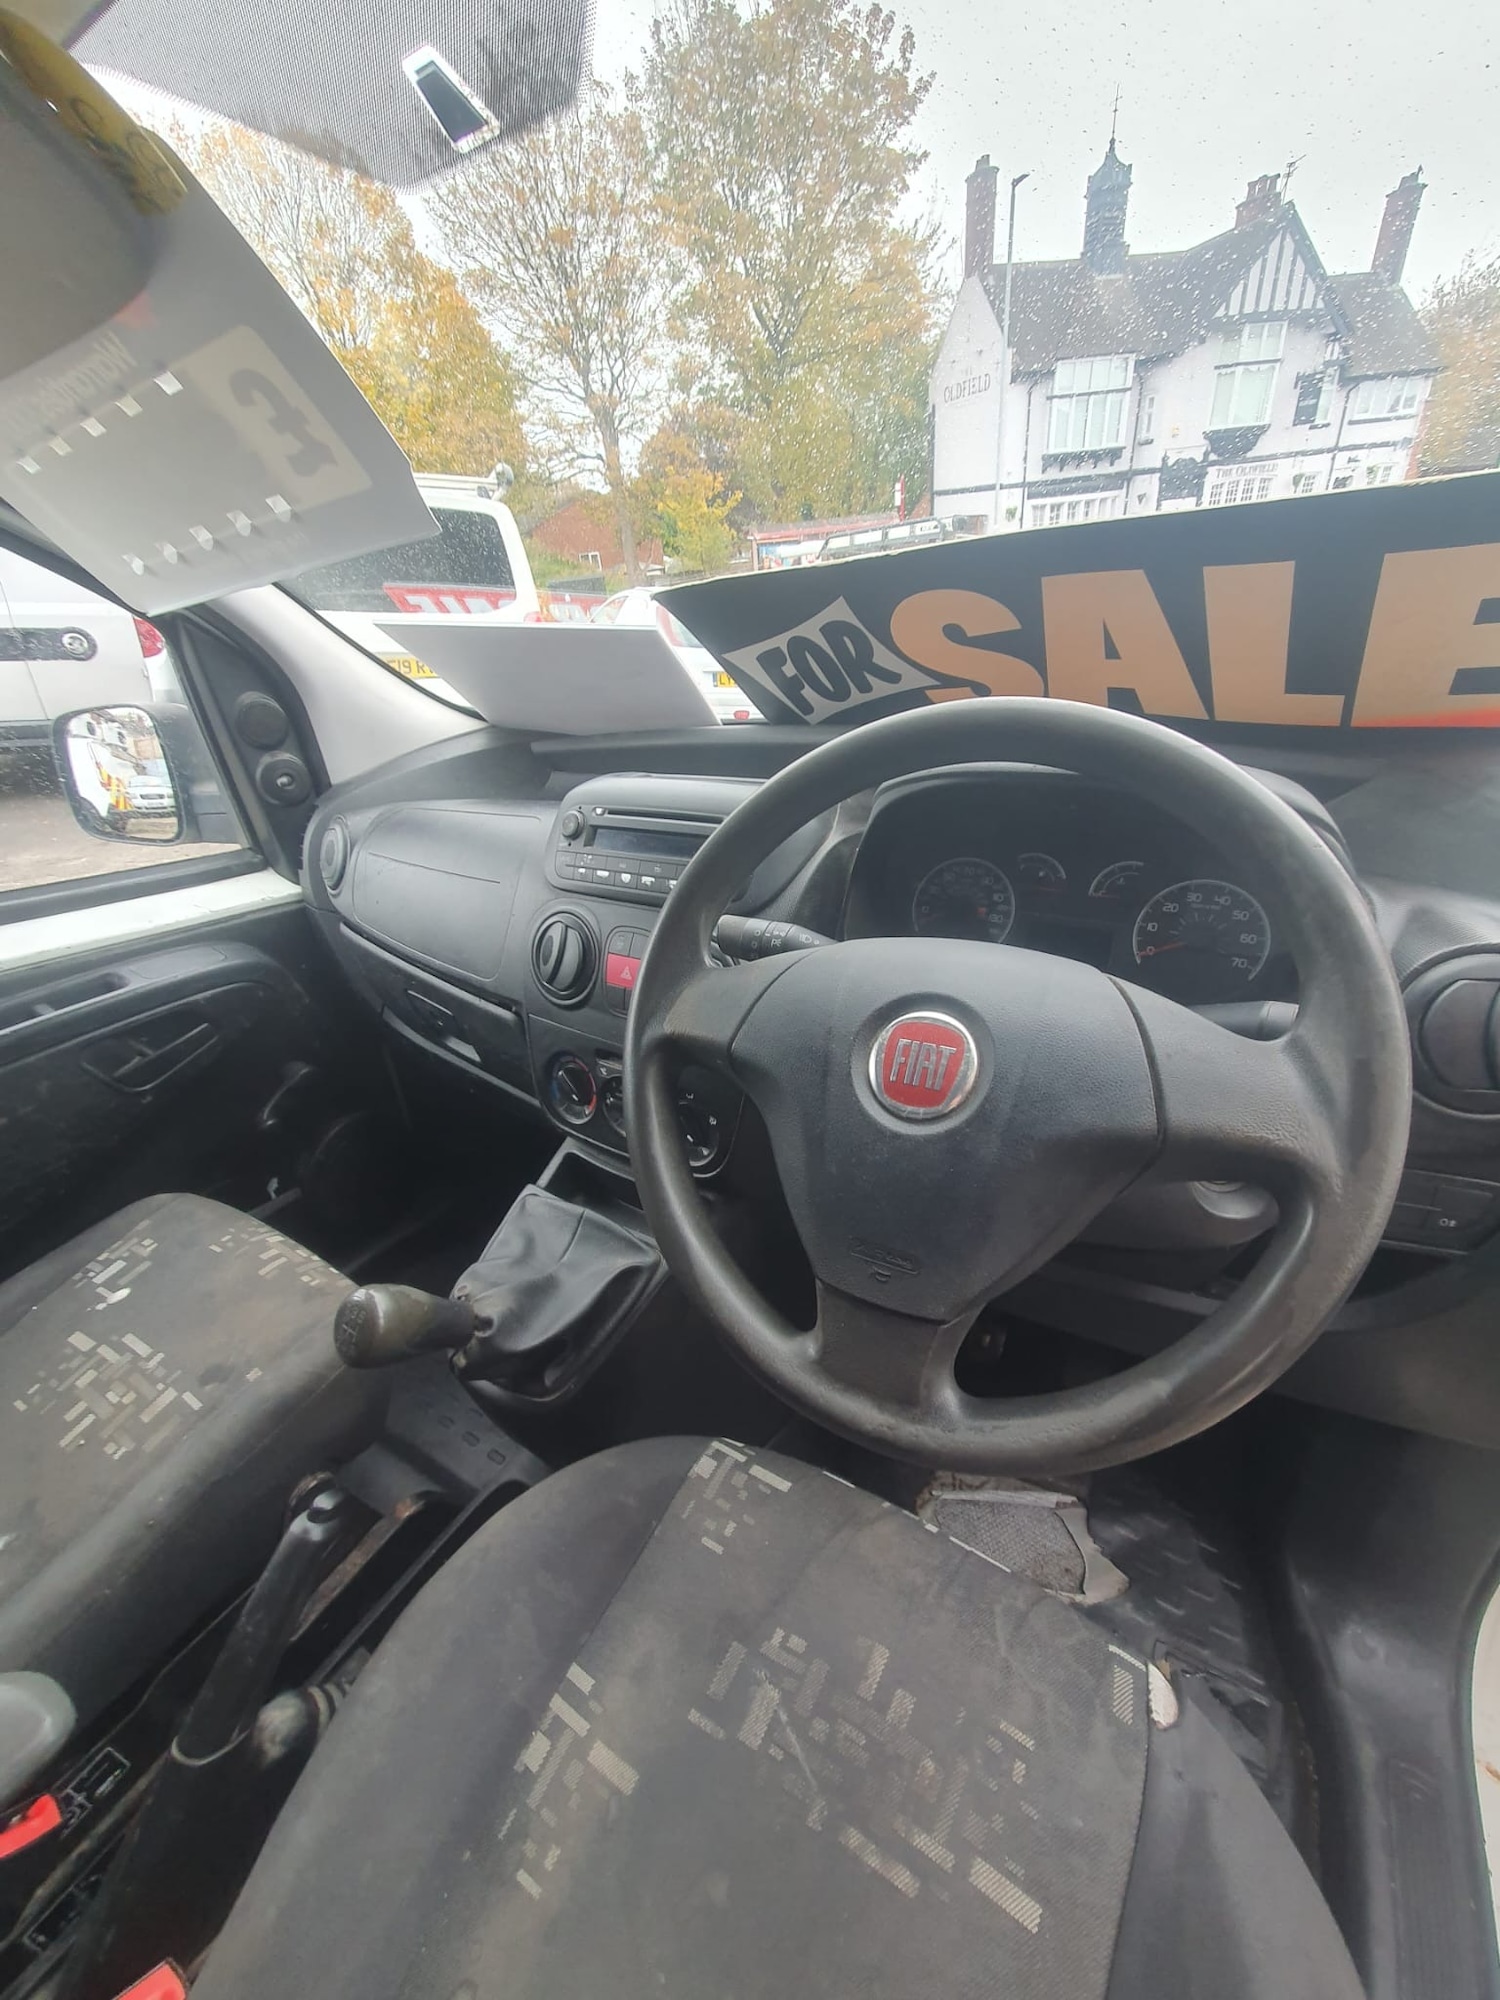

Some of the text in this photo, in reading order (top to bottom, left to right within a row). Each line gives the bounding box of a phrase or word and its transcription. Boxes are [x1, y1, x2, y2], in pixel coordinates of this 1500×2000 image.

[943, 373, 991, 403] OLDFIELD
[756, 542, 1500, 728] FOR SALE
[1186, 892, 1202, 902] 30
[1214, 895, 1231, 906] 40
[1162, 902, 1179, 913] 20
[1232, 910, 1249, 921] 50
[1147, 922, 1158, 932] 10
[1239, 934, 1257, 944] 60
[1146, 946, 1155, 955] 0
[1230, 957, 1247, 968] 70
[889, 1038, 957, 1091] FIAT
